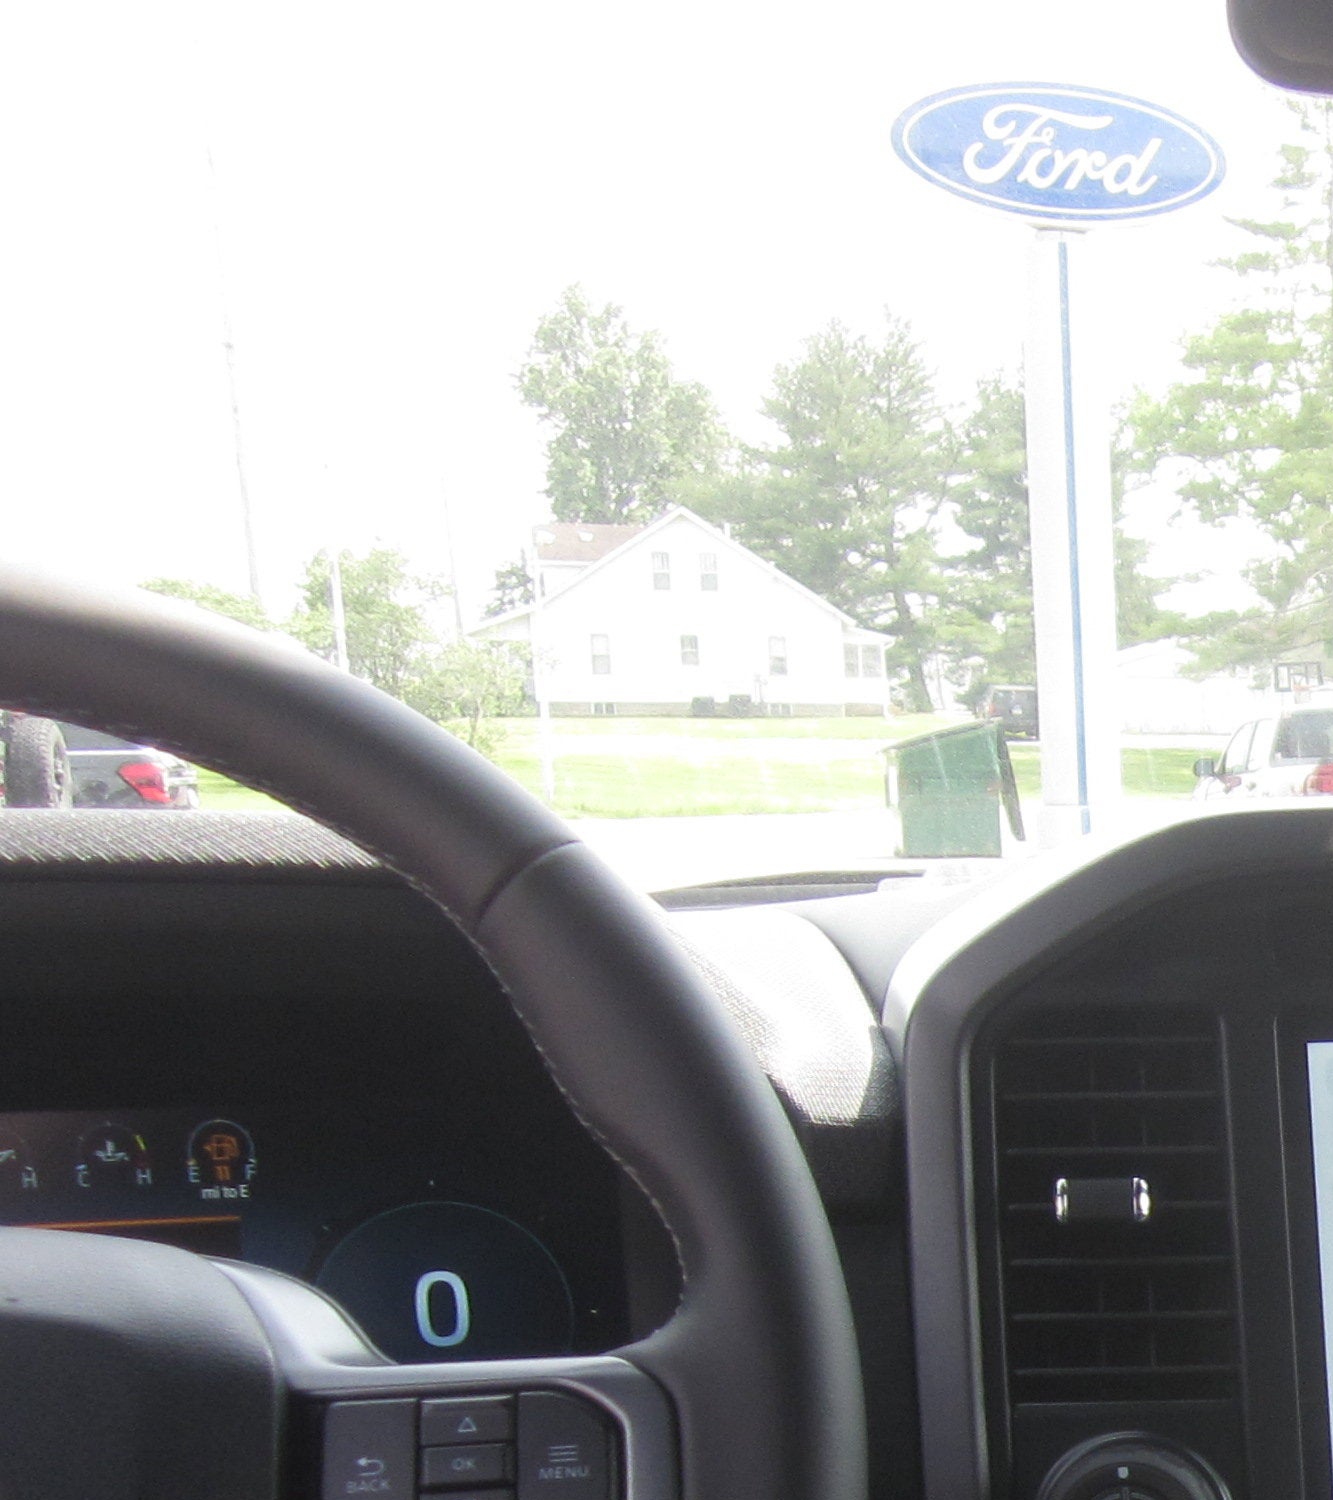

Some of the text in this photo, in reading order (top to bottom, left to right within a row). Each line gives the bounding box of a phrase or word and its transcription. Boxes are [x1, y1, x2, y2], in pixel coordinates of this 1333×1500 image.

[963, 103, 1163, 196] Ford
[136, 1168, 152, 1185] H
[240, 1185, 249, 1198] E
[414, 1270, 471, 1348] 0
[452, 1457, 477, 1471] OK
[538, 1466, 590, 1480] MENU
[347, 1480, 391, 1494] BACK
